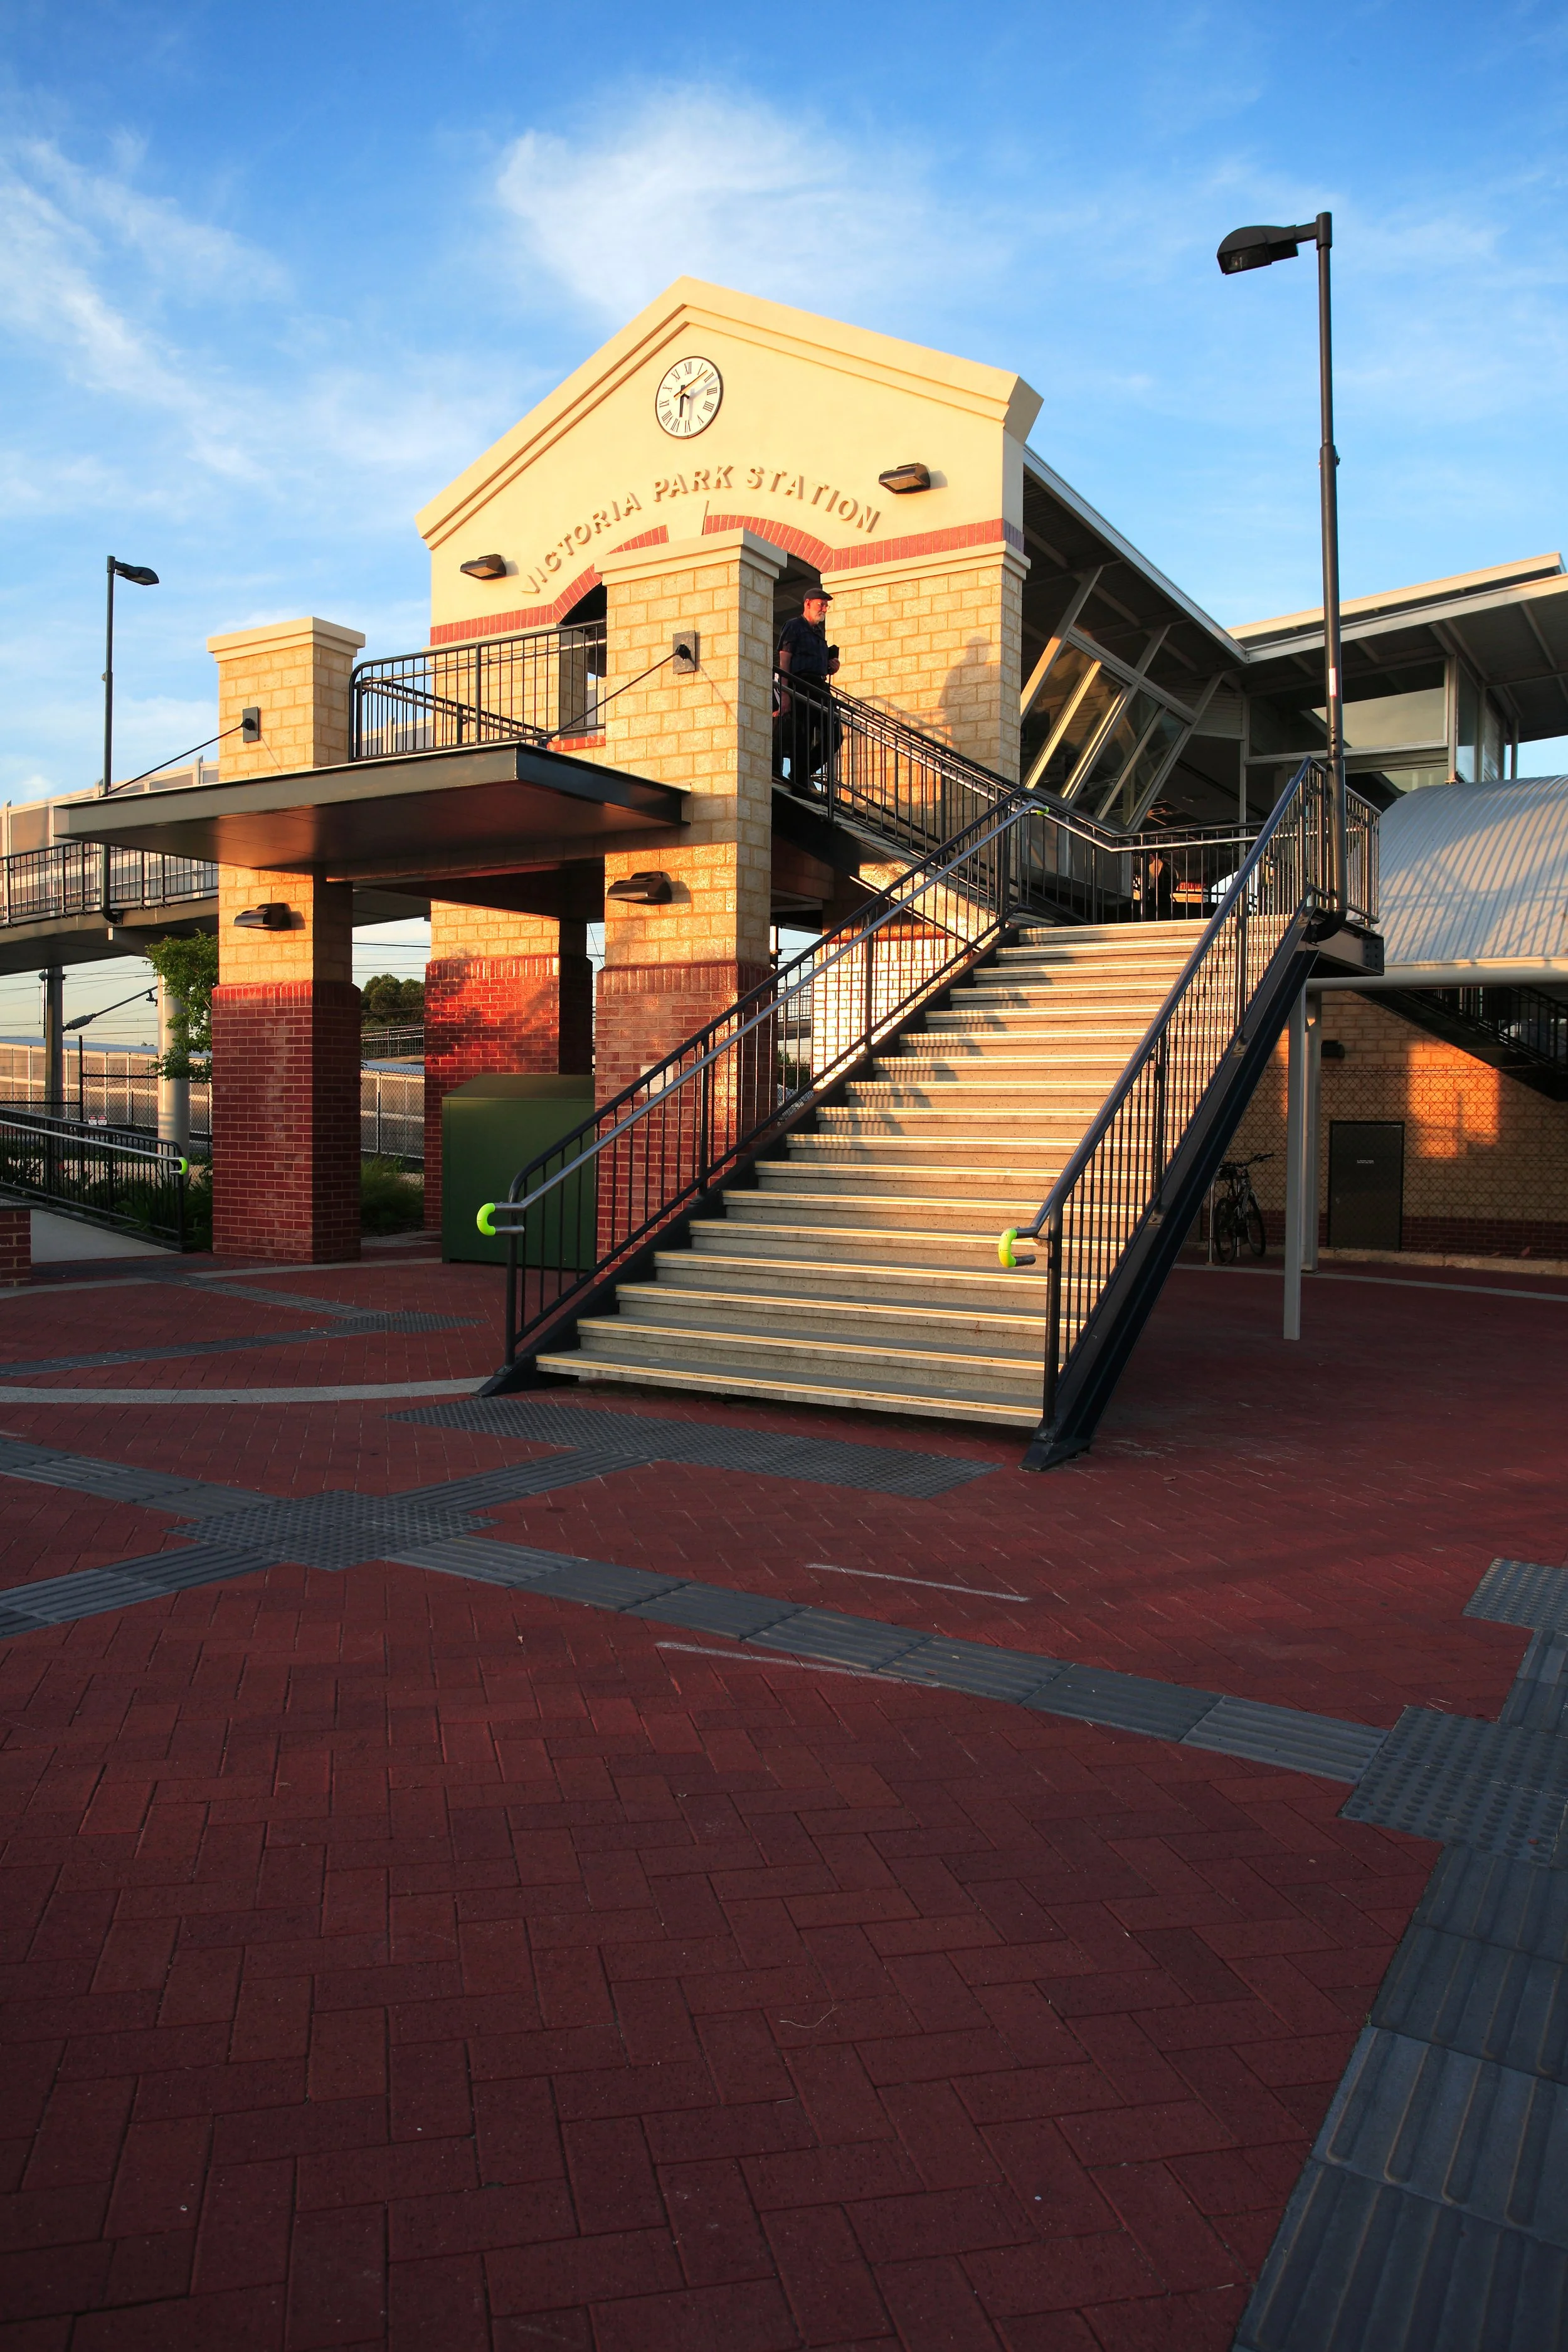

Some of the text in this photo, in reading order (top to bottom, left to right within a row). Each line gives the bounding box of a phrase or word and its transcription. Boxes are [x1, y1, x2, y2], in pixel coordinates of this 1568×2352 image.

[671, 369, 681, 382] XI
[704, 372, 714, 383] II
[707, 386, 718, 396] III
[659, 400, 669, 408] IX
[520, 465, 881, 593] VICTORIA PARK STATION
